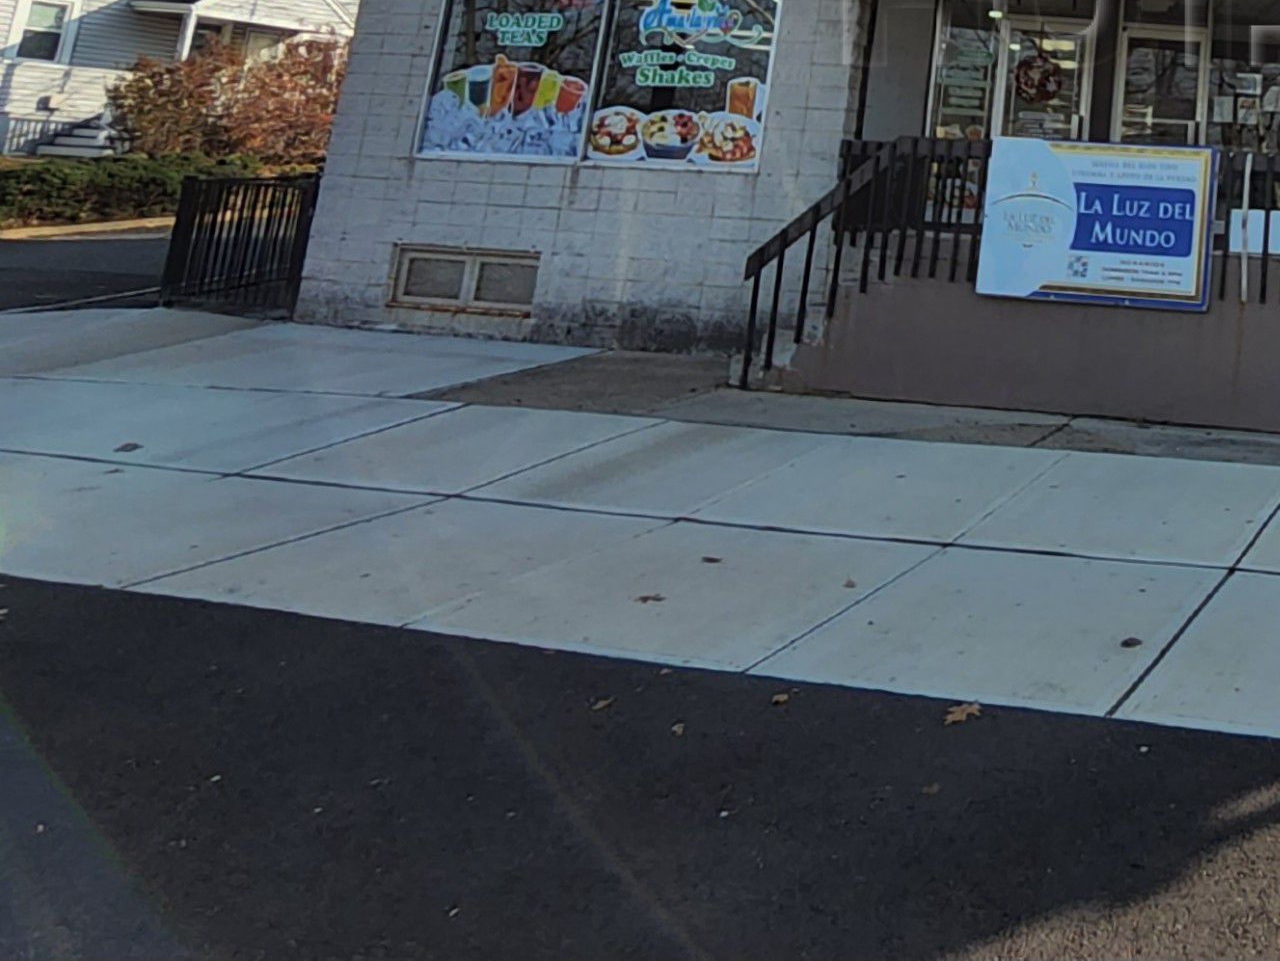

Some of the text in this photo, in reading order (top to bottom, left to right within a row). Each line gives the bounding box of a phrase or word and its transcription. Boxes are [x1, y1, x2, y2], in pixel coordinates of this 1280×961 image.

[486, 12, 563, 30] LOADED
[620, 50, 676, 67] Waffles
[636, 67, 715, 86] Shakes
[1078, 191, 1195, 222] LA LUZ DEL
[1090, 221, 1177, 249] MUNDO
